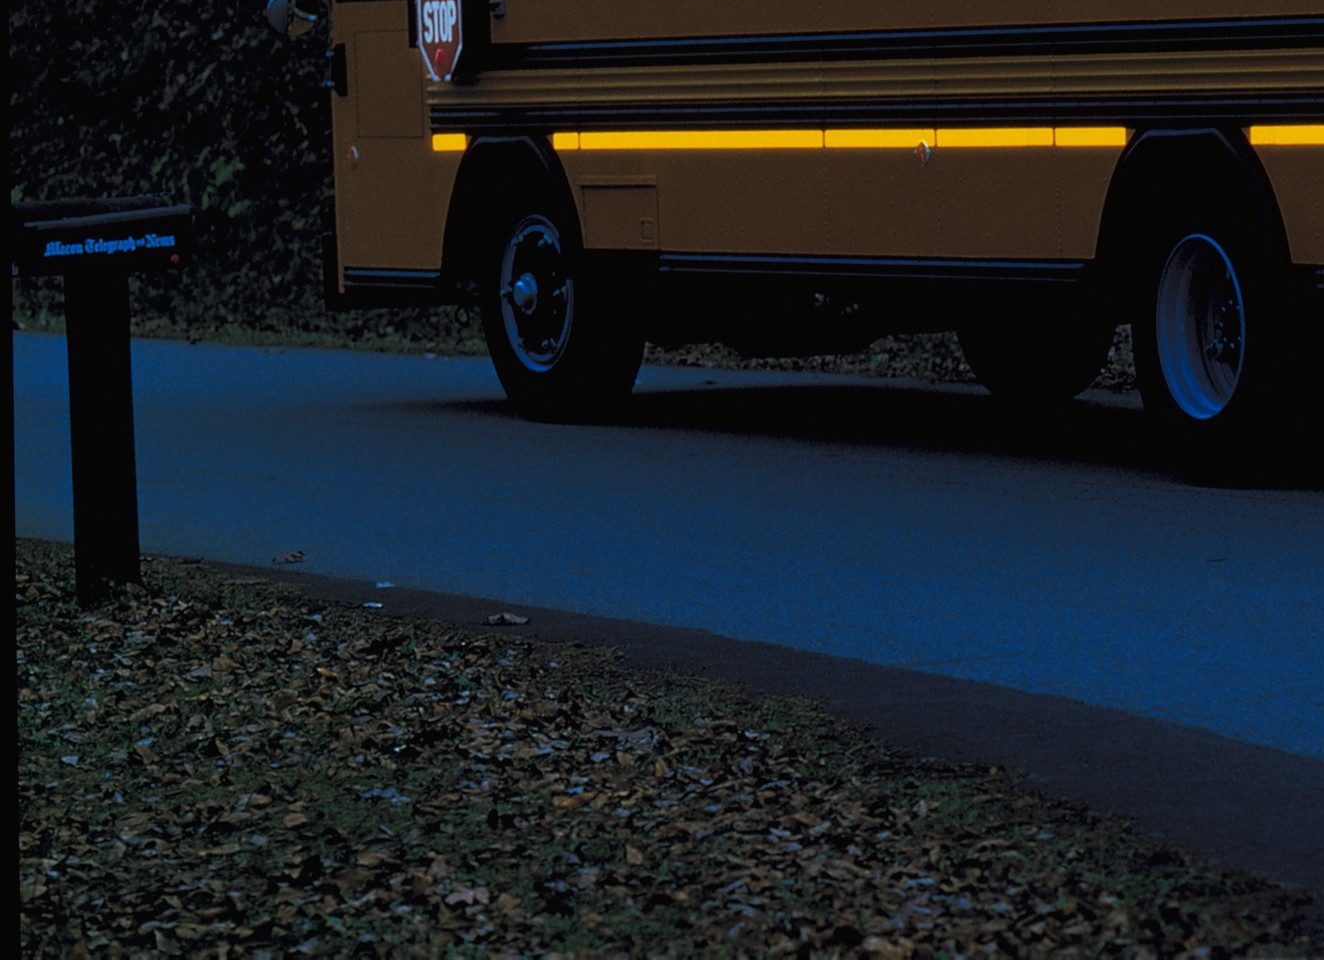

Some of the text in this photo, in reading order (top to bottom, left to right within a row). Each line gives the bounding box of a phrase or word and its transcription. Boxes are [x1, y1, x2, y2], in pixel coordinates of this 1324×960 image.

[423, 0, 457, 44] STOP
[44, 241, 83, 257] Macon
[84, 235, 136, 255] Telegraph
[145, 233, 175, 249] News
